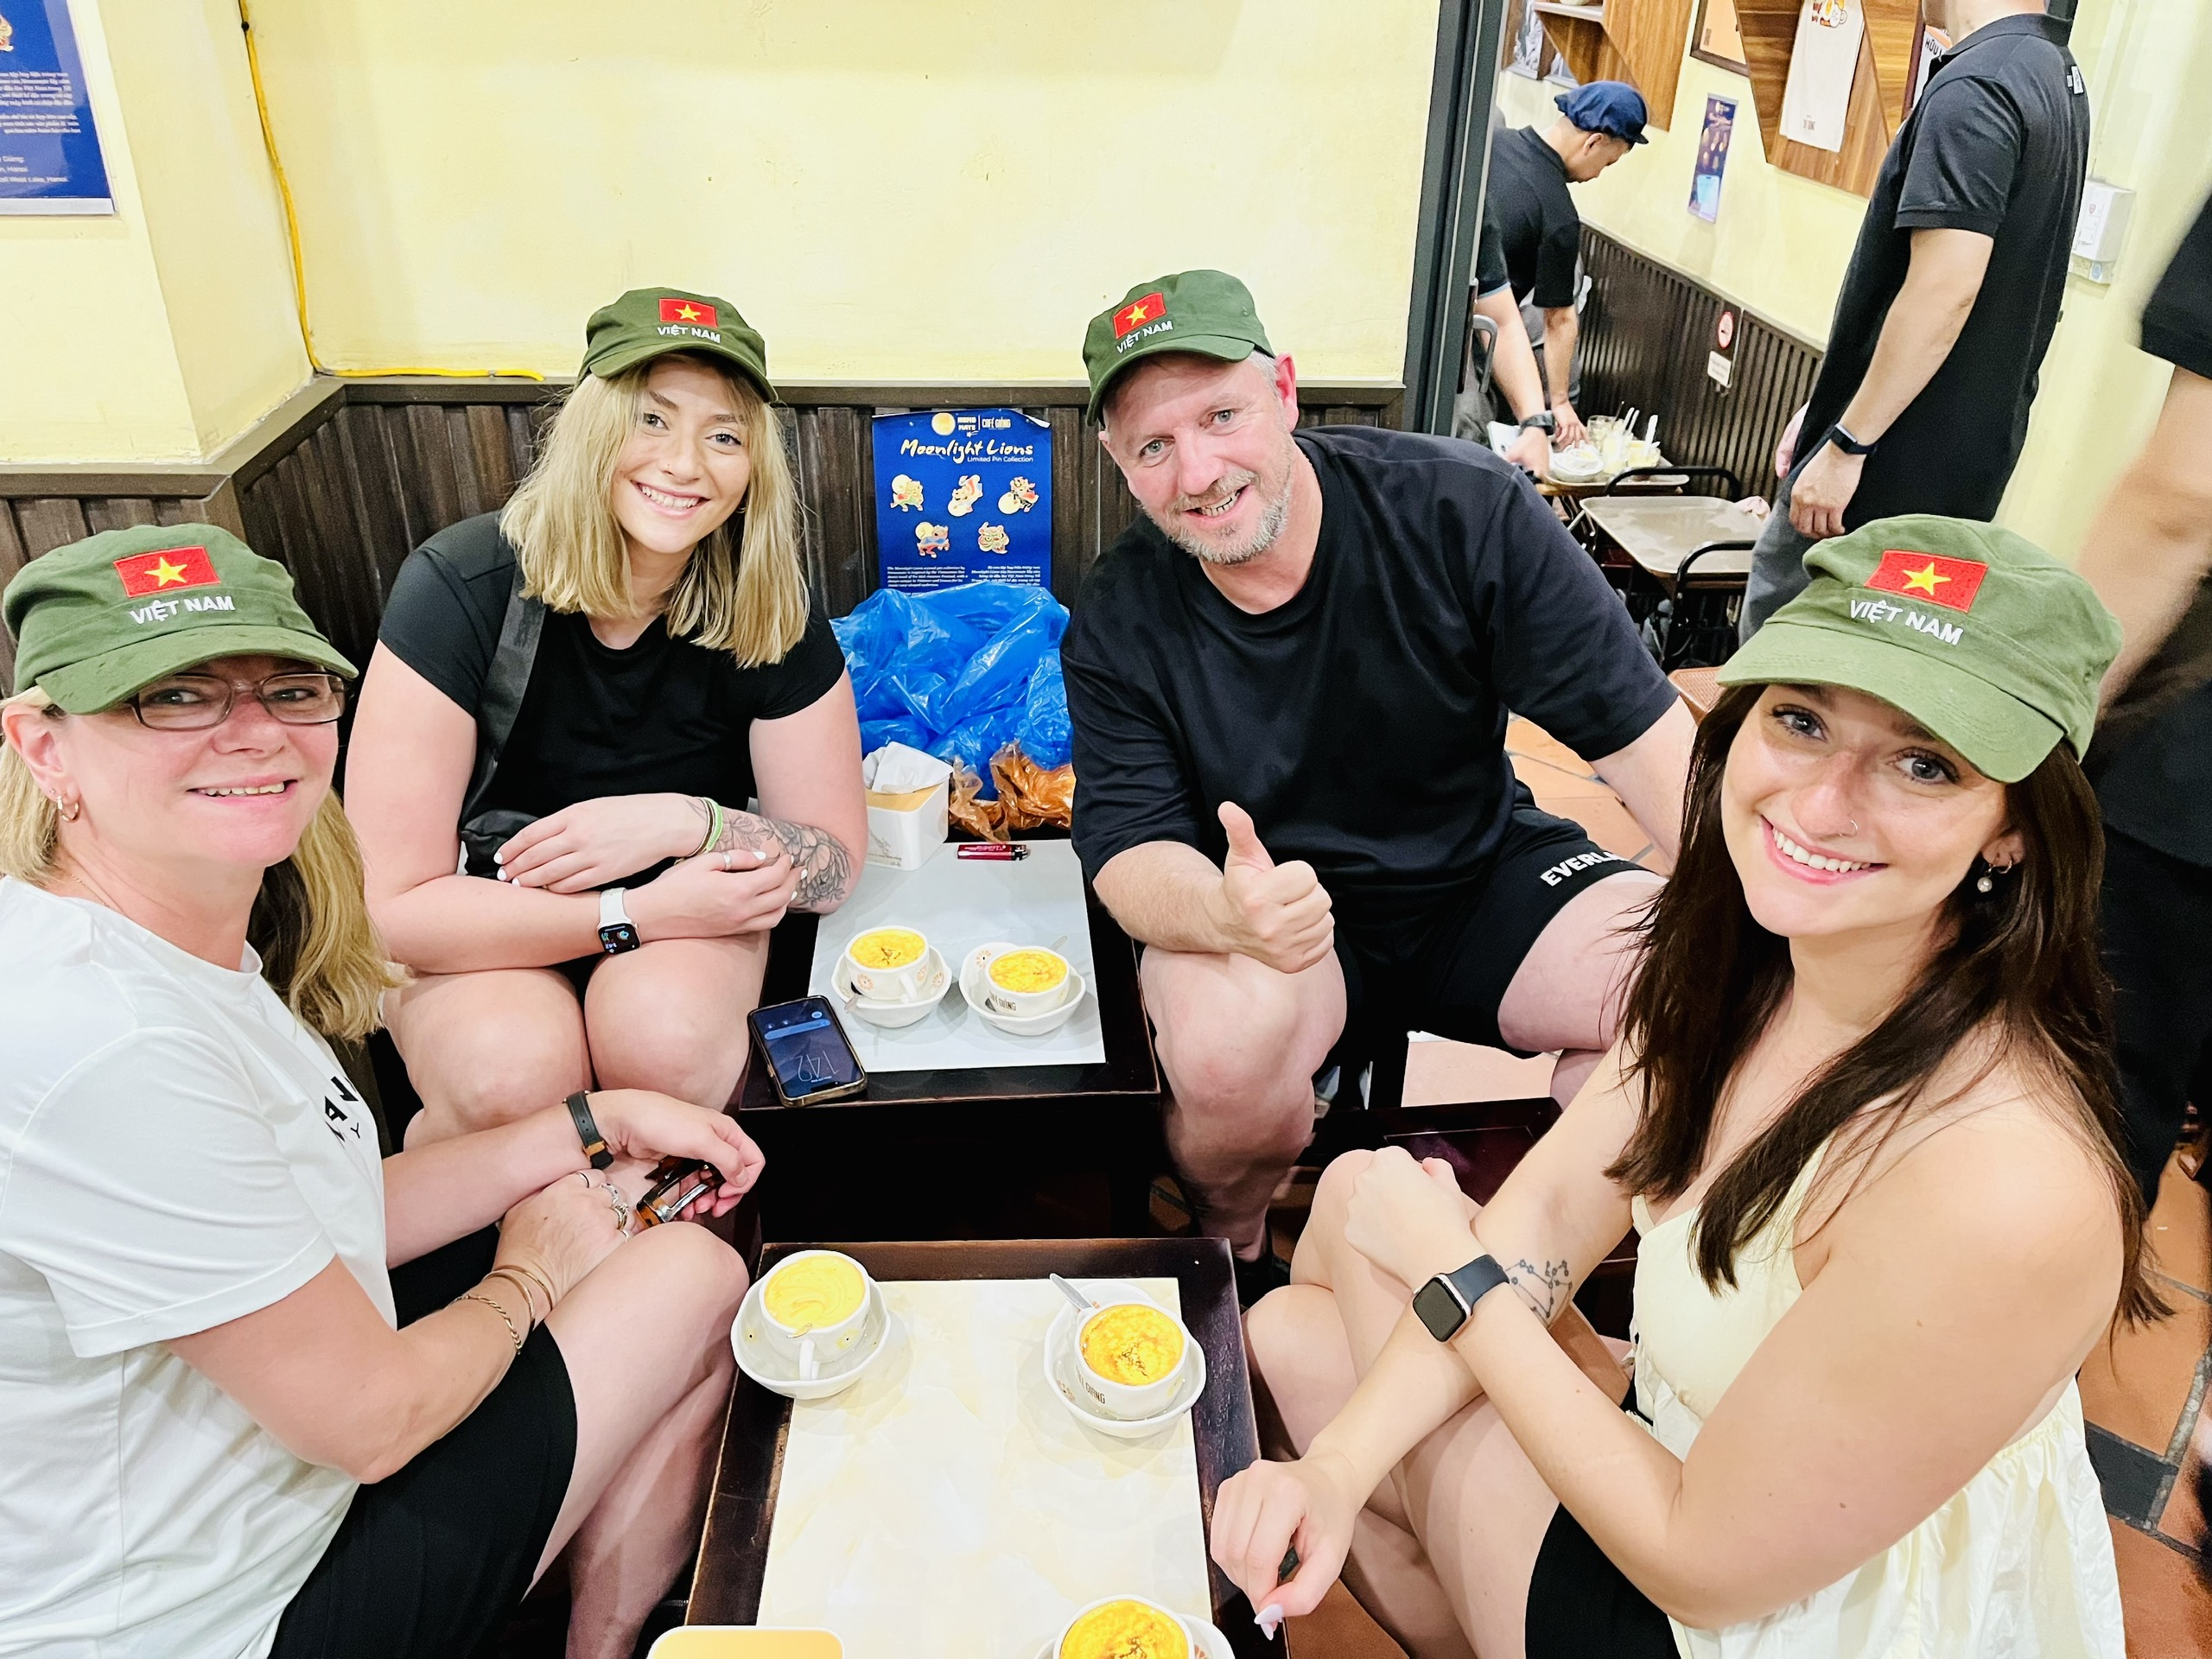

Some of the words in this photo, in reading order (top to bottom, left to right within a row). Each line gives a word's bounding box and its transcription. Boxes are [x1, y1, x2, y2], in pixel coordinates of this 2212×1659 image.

[657, 323, 689, 336] VIỆT
[690, 327, 721, 344] NAM
[1116, 331, 1141, 354] VIỆT
[1142, 320, 1173, 337] NAM
[900, 439, 983, 464] Moonlight
[986, 439, 1033, 456] Lions
[130, 600, 180, 624] VIỆT
[183, 595, 236, 612] NAM
[1850, 599, 1904, 624] VIỆT
[1904, 611, 1964, 645] NAM
